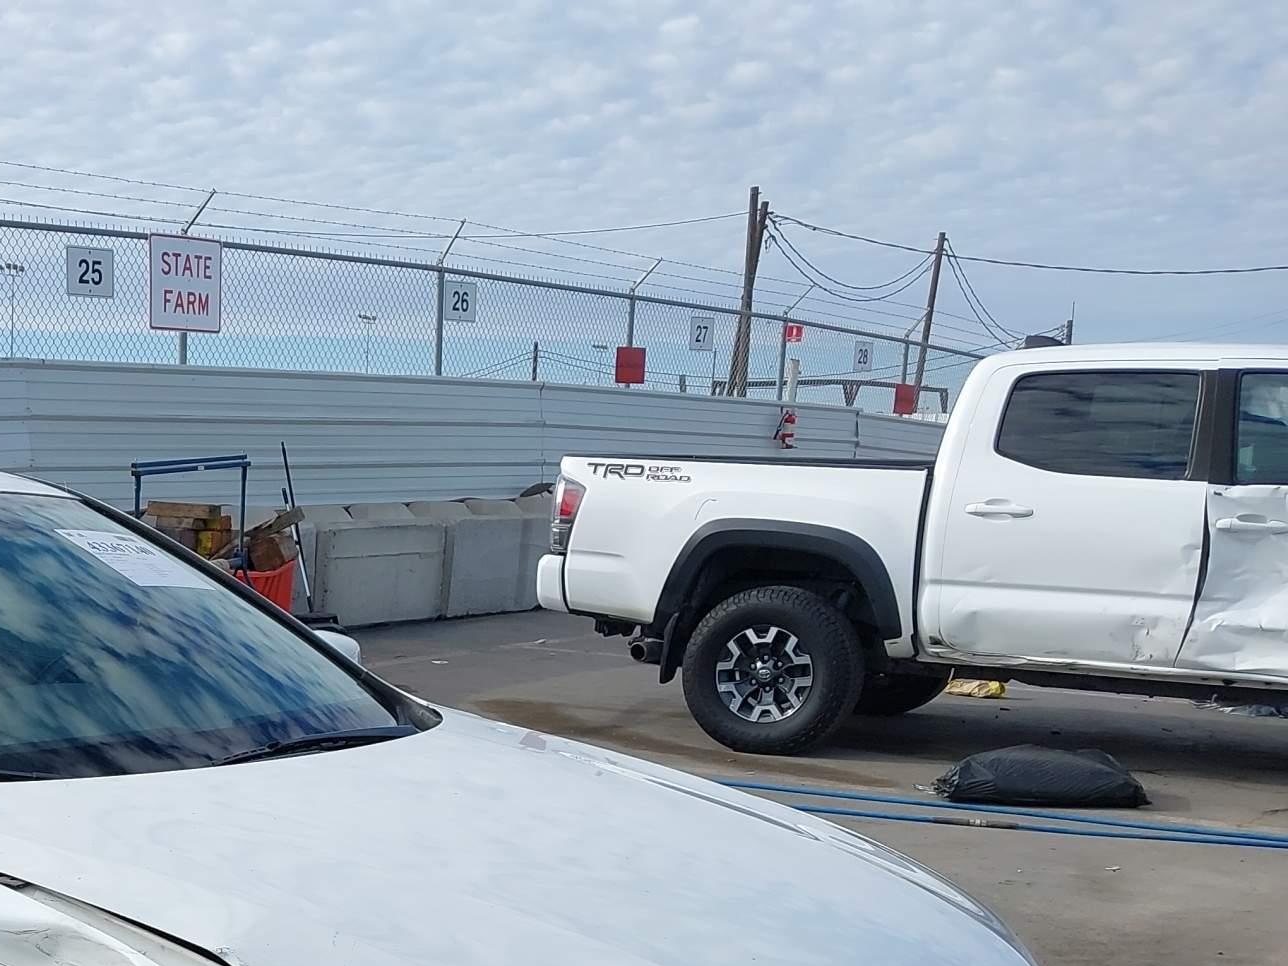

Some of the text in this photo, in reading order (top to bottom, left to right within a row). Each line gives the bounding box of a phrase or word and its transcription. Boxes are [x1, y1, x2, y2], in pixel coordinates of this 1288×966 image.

[78, 258, 103, 286] 25
[161, 251, 213, 280] STATE
[163, 289, 210, 317] FARM
[452, 290, 469, 313] 26
[695, 324, 709, 344] 27
[857, 348, 868, 365] 28
[586, 462, 682, 481] TRD OFF
[645, 474, 692, 482] ROAD
